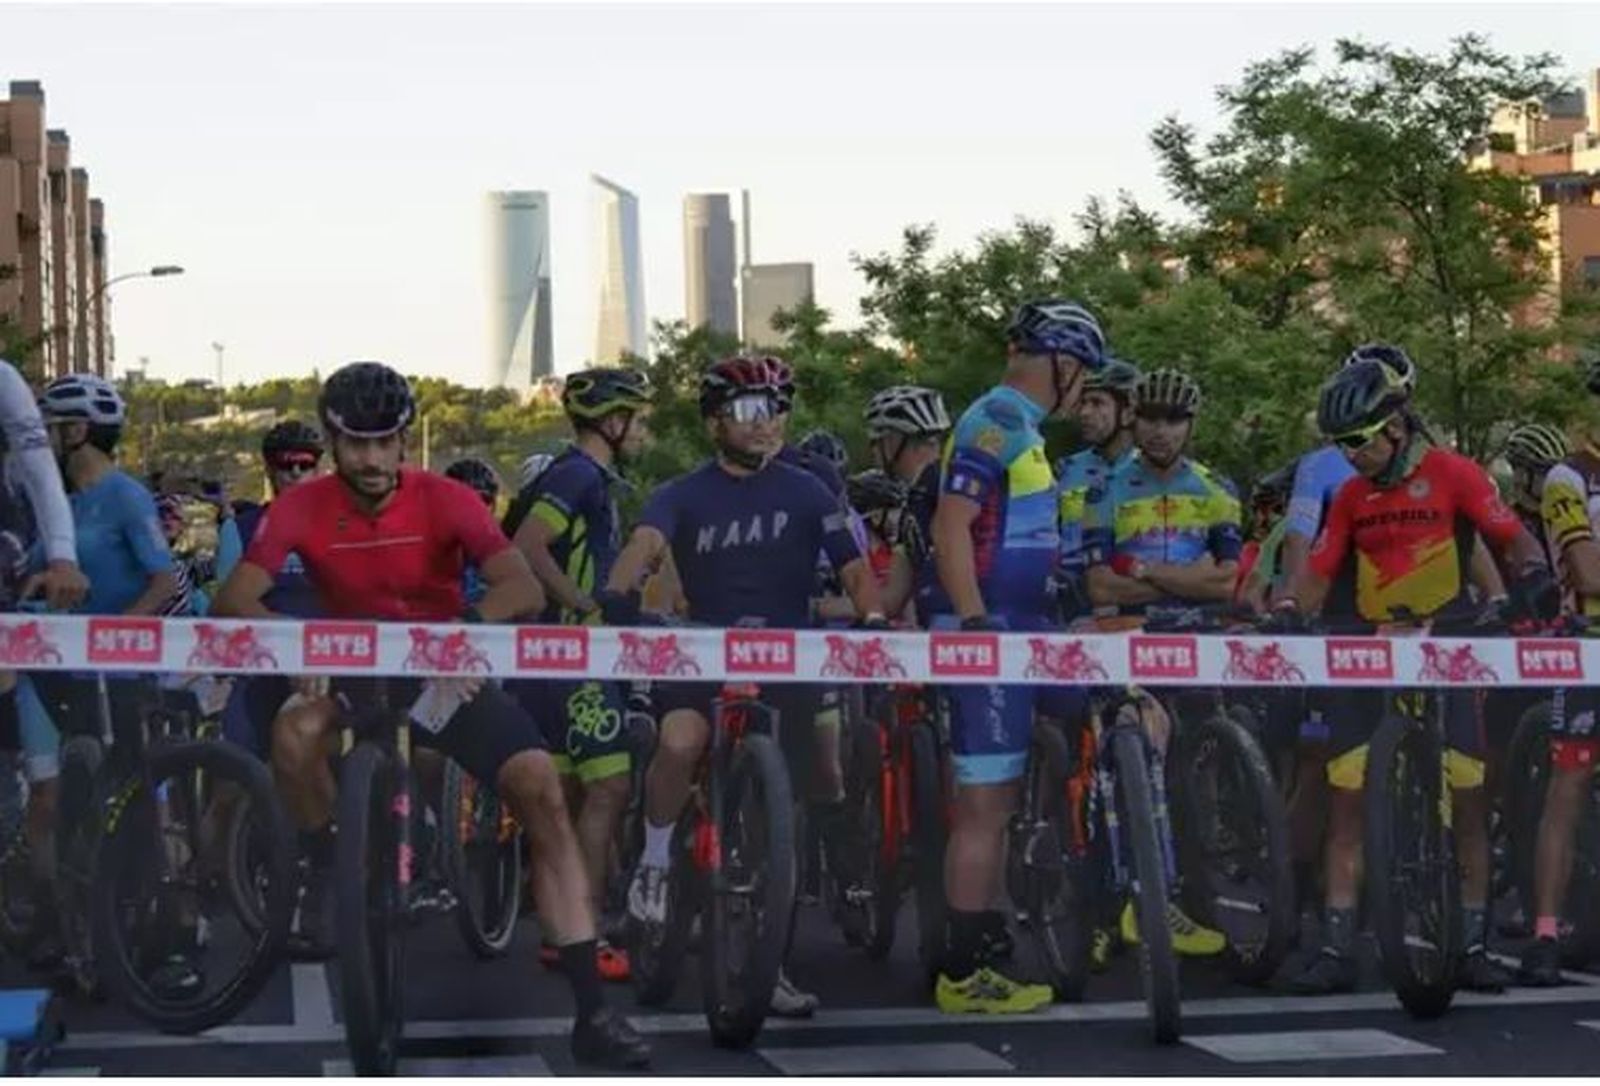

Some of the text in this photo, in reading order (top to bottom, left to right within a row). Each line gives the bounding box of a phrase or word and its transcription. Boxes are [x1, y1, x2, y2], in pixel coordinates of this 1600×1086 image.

[96, 629, 155, 651] MTB
[310, 634, 370, 656] MTB
[523, 638, 582, 660] MTB
[731, 641, 788, 663] MTB
[936, 644, 992, 666] MTB
[1135, 646, 1191, 667] MTB
[1332, 648, 1387, 669] MTB
[1522, 650, 1576, 670] MTB
